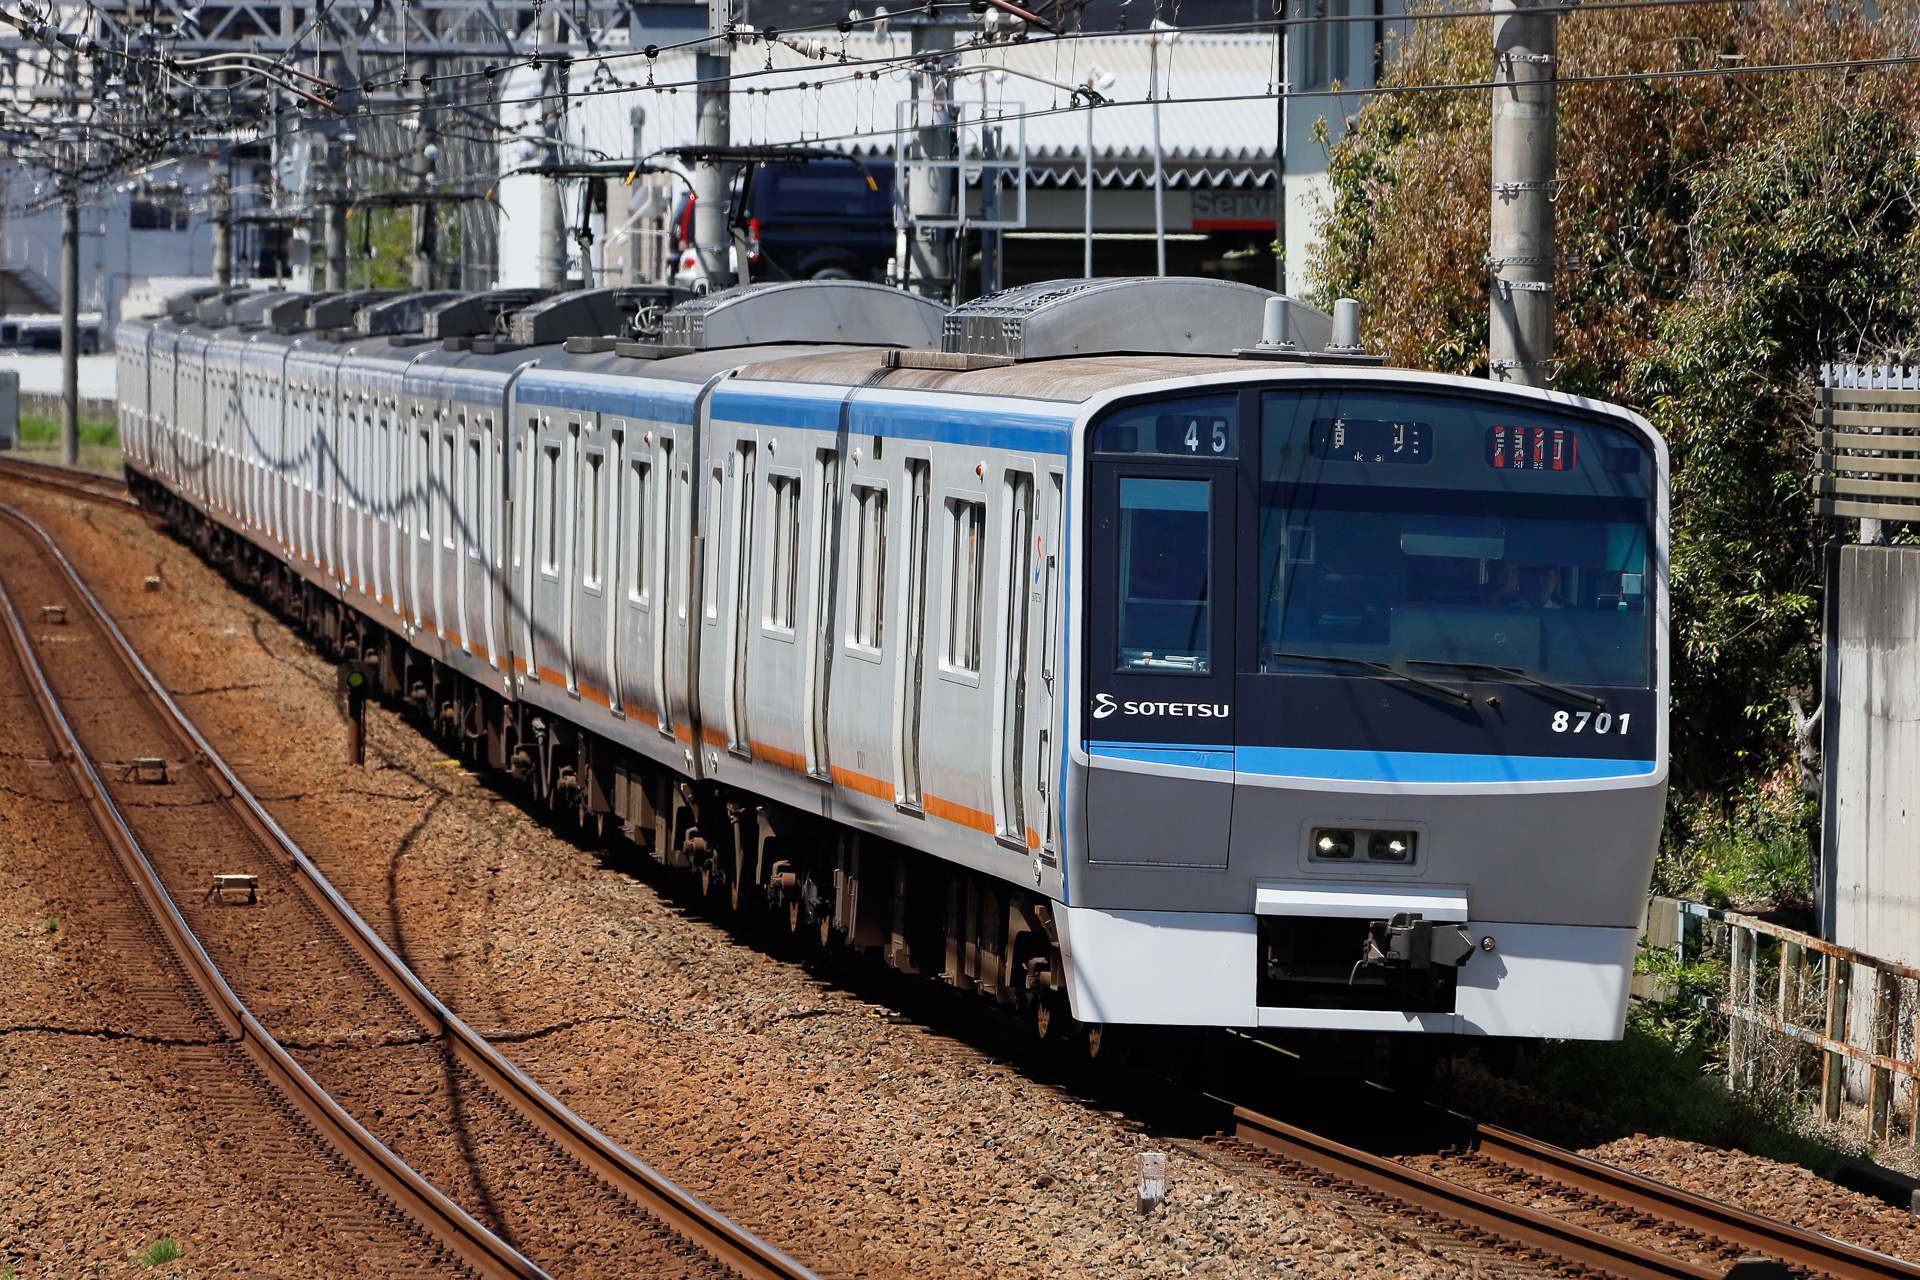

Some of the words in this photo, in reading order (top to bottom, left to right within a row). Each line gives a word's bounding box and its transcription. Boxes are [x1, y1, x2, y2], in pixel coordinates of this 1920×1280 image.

[1184, 420, 1226, 453] 45
[1124, 701, 1229, 718] SOTETSU
[1551, 710, 1631, 735] 8701
